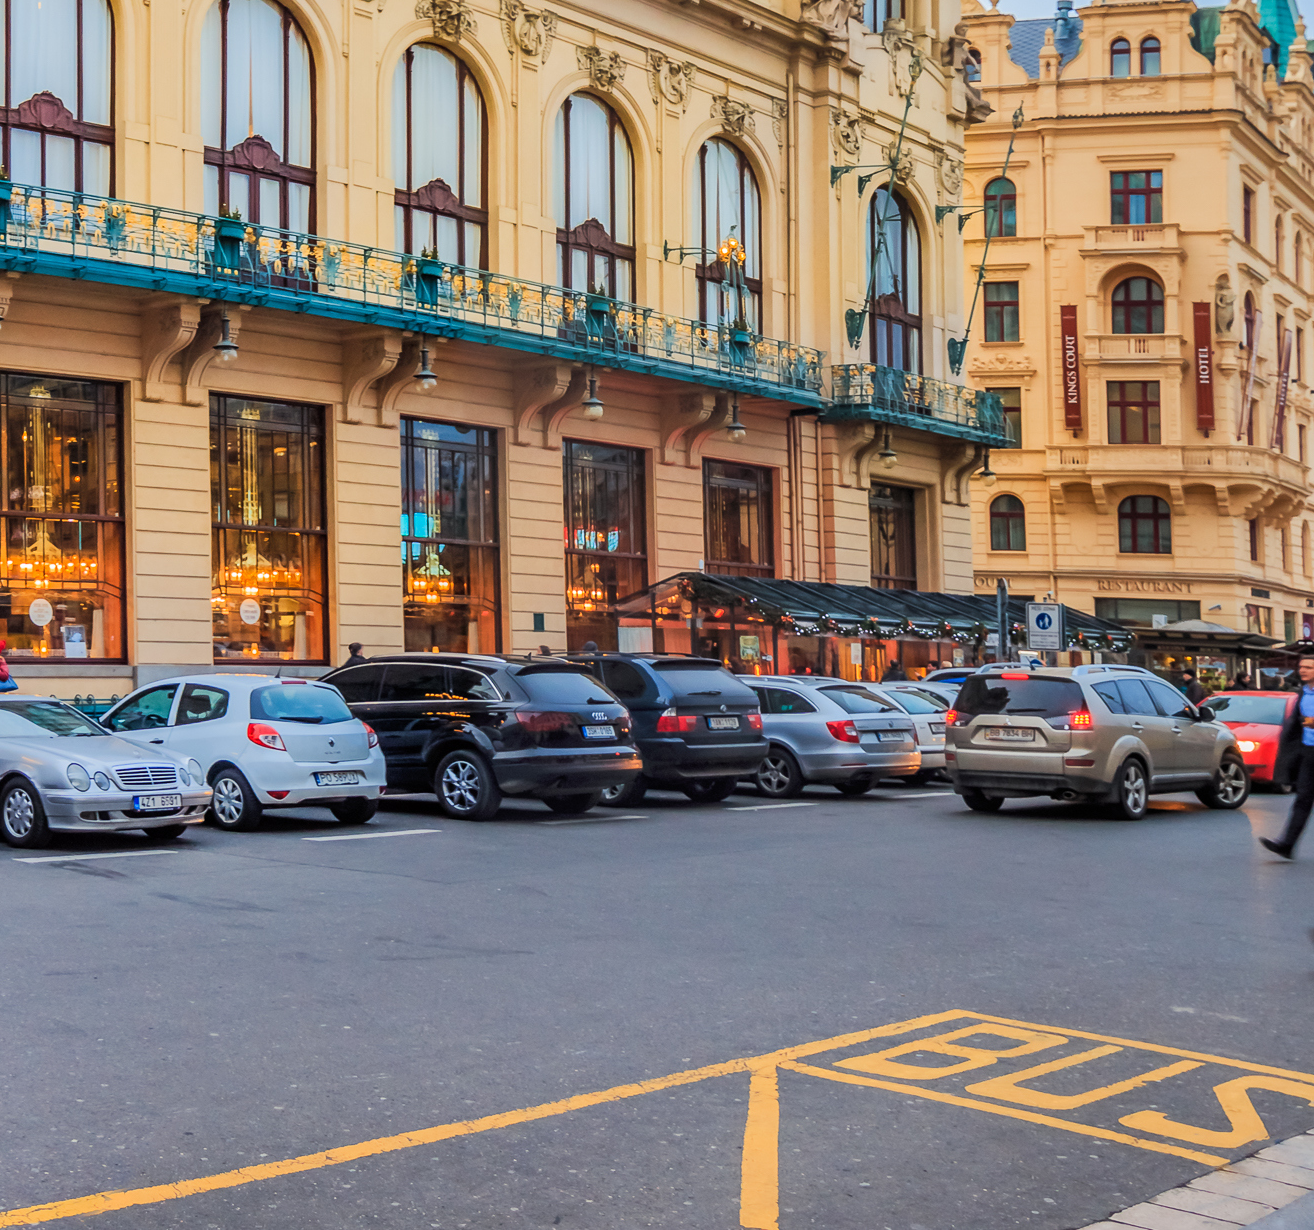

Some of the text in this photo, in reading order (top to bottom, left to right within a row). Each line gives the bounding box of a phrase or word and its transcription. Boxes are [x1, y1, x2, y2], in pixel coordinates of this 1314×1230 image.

[1065, 335, 1078, 404] KINGS COURT
[1198, 346, 1210, 384] HOTEL
[1097, 579, 1193, 594] RESTAURANT
[320, 773, 332, 782] PO
[141, 796, 155, 807] 4Z1
[831, 1021, 1314, 1149] BUS
